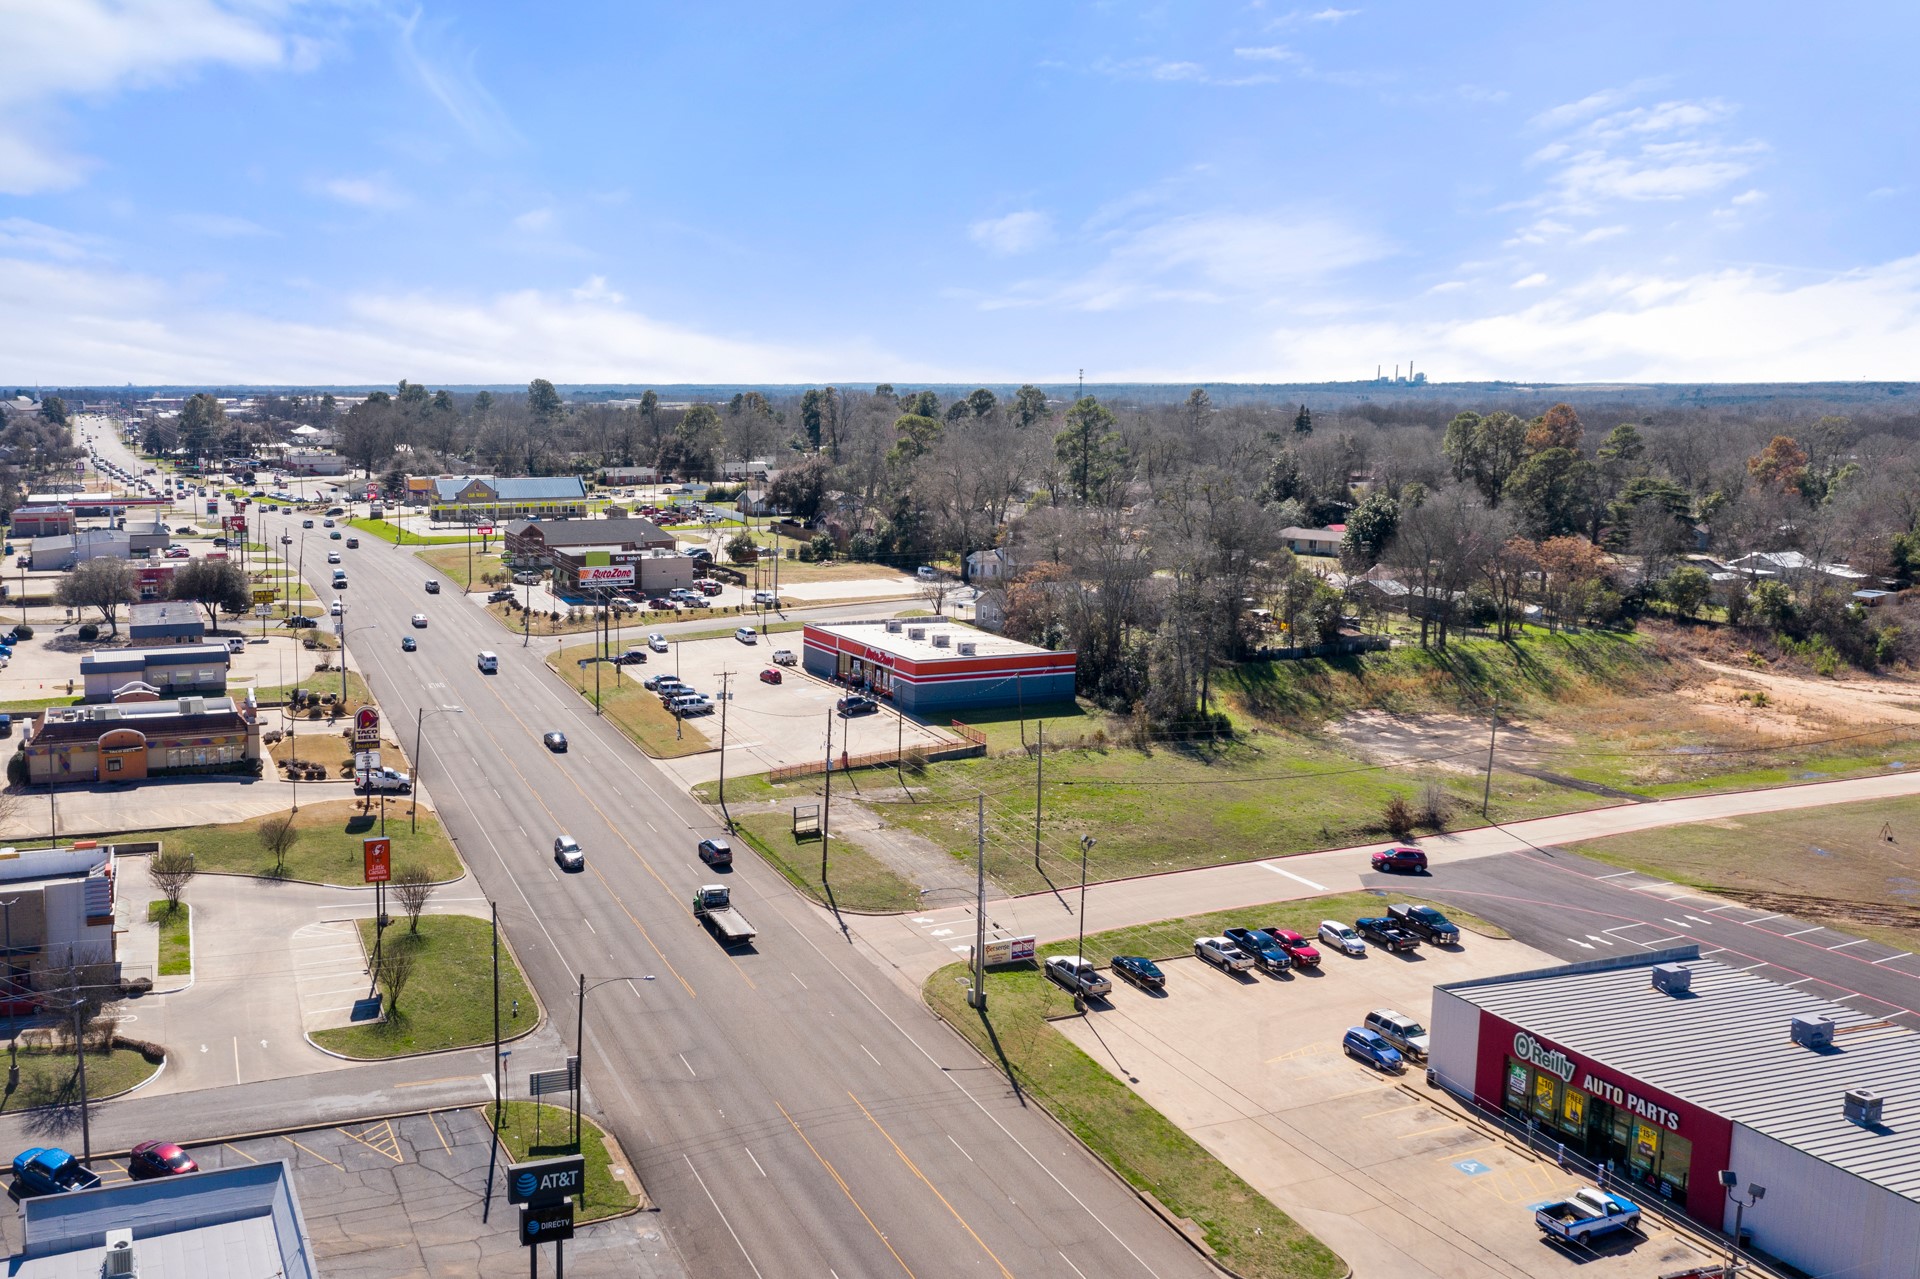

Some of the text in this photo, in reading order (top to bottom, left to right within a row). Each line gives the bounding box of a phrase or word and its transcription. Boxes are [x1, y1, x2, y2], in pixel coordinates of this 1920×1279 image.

[592, 568, 632, 579] AutoZone
[1515, 1034, 1574, 1081] O'Reilly
[1567, 1092, 1583, 1105] FREE
[1583, 1074, 1680, 1130] AUTO PARTS
[540, 1170, 579, 1190] AT&T
[541, 1219, 570, 1230] DIRECTV
